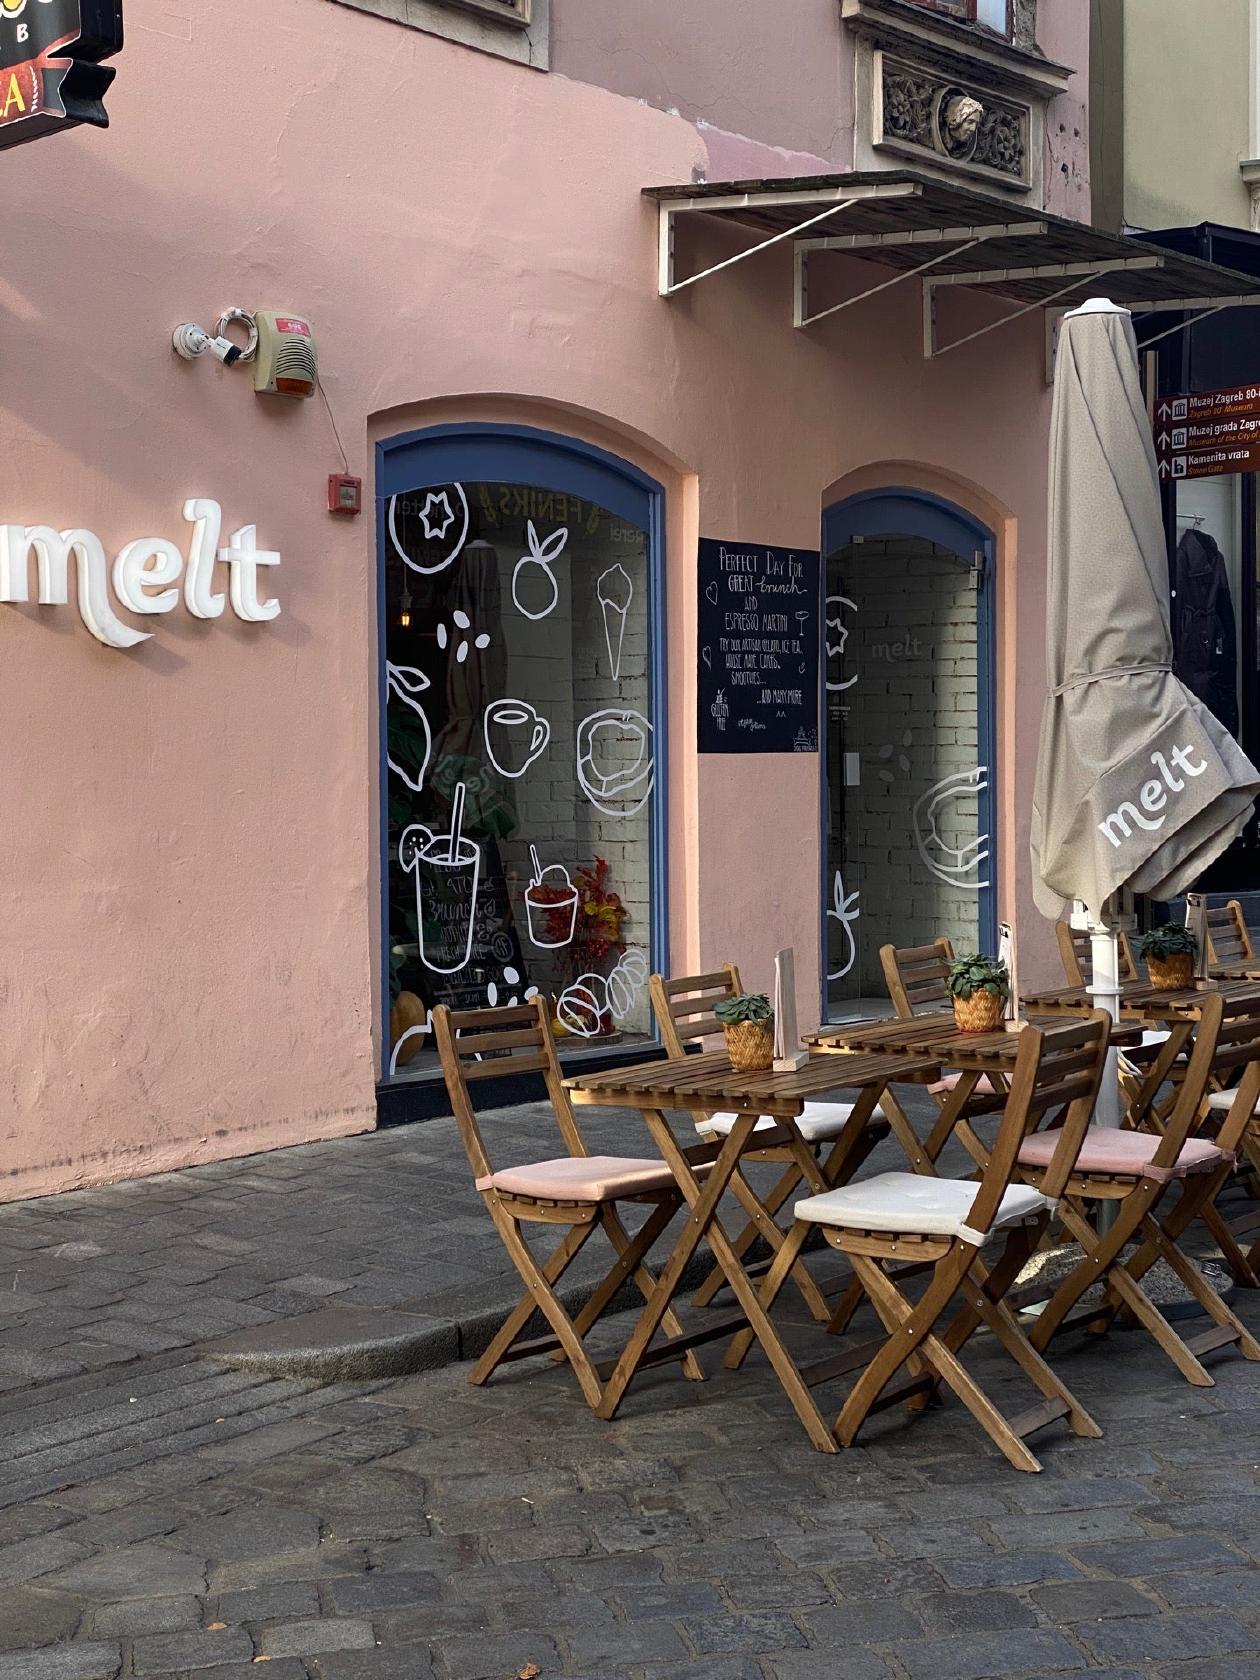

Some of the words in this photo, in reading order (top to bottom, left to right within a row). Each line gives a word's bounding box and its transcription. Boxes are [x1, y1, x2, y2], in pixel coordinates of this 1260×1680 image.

[0, 72, 26, 117] A
[1189, 395, 1214, 408] Muzej
[1215, 390, 1244, 405] Zagreb
[1188, 423, 1213, 437] Muzej
[1214, 421, 1238, 435] grada
[1188, 451, 1226, 465] Kamenita
[1228, 449, 1250, 460] vrata
[0, 497, 281, 648] melt
[728, 574, 754, 592] GREAT
[744, 595, 758, 611] AND
[724, 612, 759, 631] ESPRESSO
[762, 613, 788, 632] MARTINI
[871, 634, 922, 662] melt
[1097, 744, 1208, 848] melt
